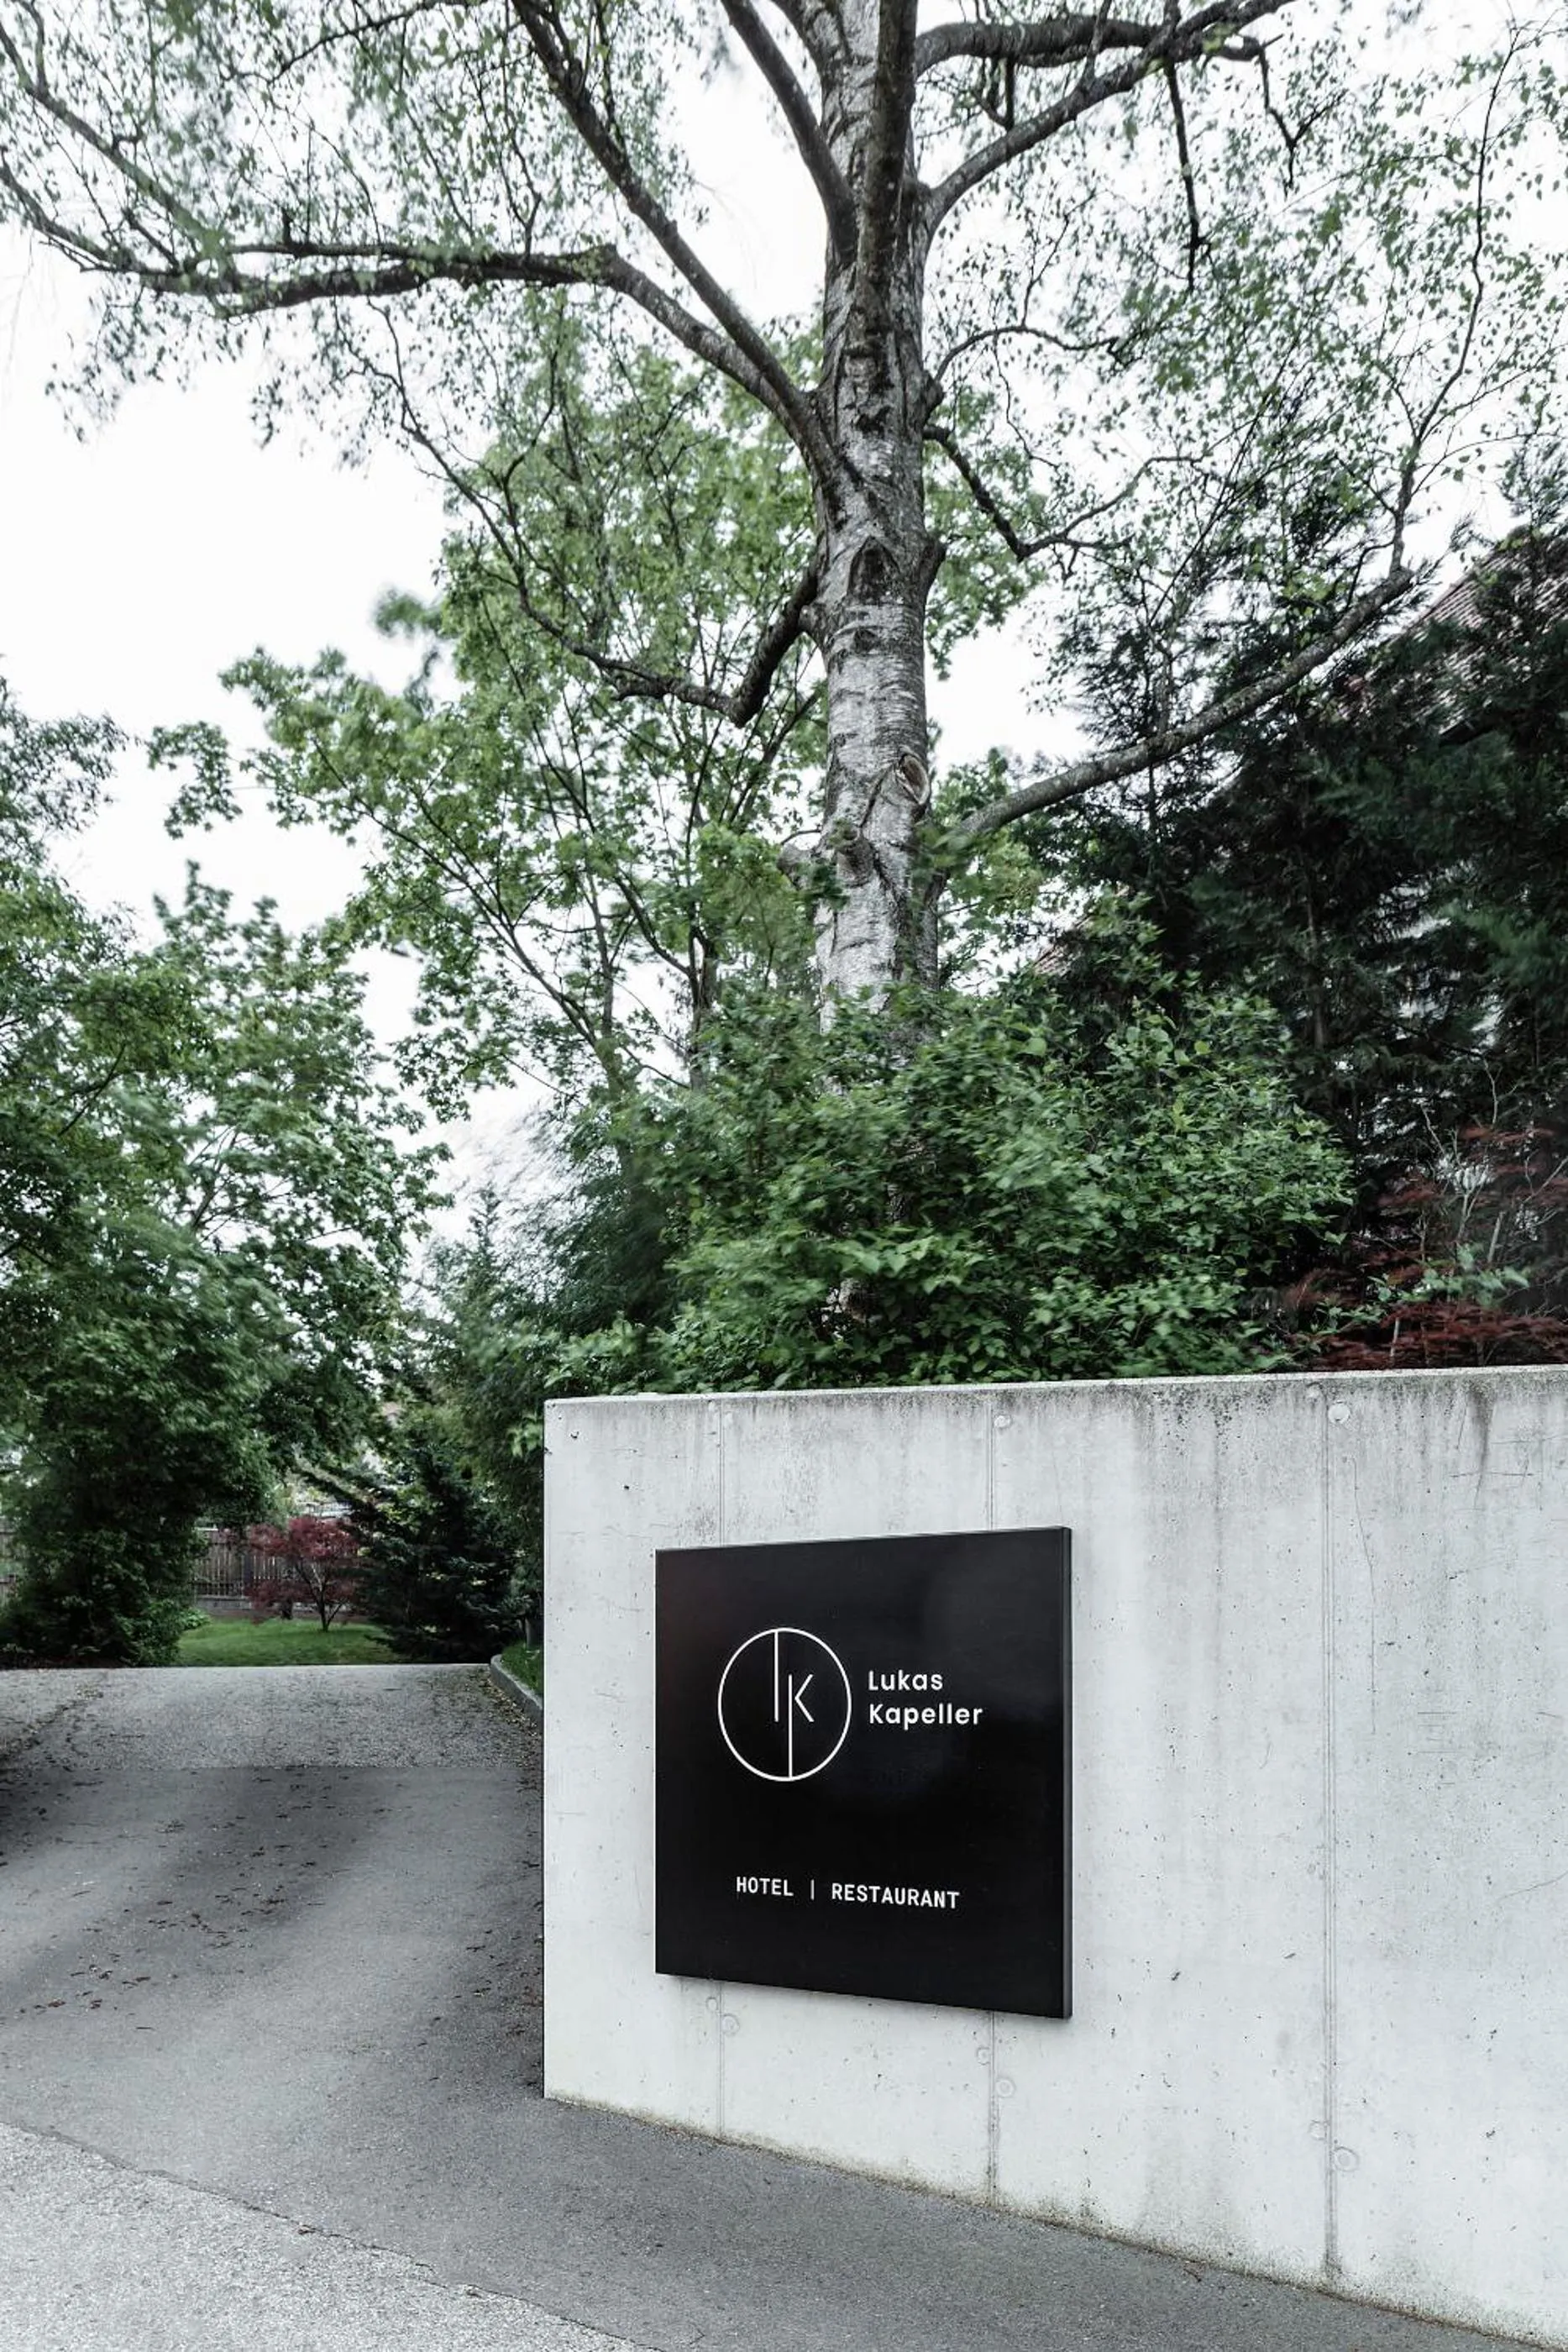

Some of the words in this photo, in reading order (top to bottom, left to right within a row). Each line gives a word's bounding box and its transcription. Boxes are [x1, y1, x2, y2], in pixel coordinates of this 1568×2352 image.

[868, 1669, 944, 1692] Lukas
[869, 1703, 983, 1730] Kapeller
[736, 1876, 794, 1897] HOTEL
[831, 1882, 960, 1909] RESTAURANT
